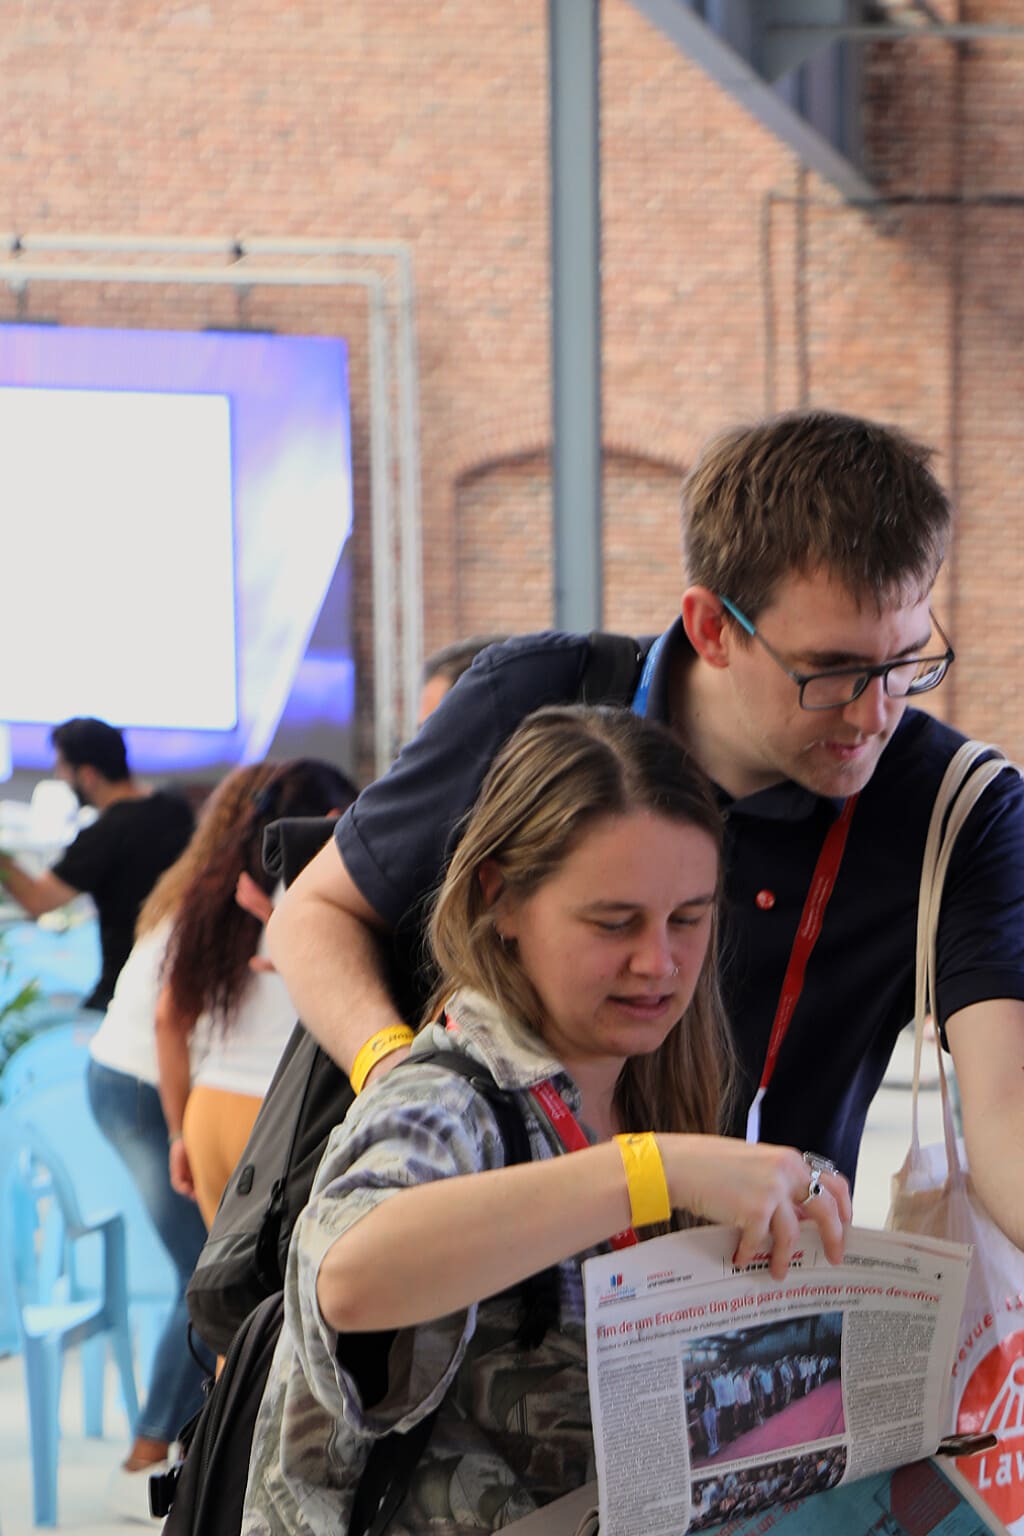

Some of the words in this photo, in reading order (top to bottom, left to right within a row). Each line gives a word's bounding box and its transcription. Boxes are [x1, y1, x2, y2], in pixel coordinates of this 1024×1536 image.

[596, 1324, 617, 1340] Fim
[619, 1320, 633, 1335] de
[635, 1317, 653, 1332] um
[730, 1294, 754, 1313] guia
[757, 1288, 783, 1307] para
[785, 1283, 843, 1299] enfrentar
[845, 1284, 883, 1297] novos
[885, 1286, 940, 1304] desafios
[951, 1311, 994, 1378] revue
[757, 1514, 776, 1533] un
